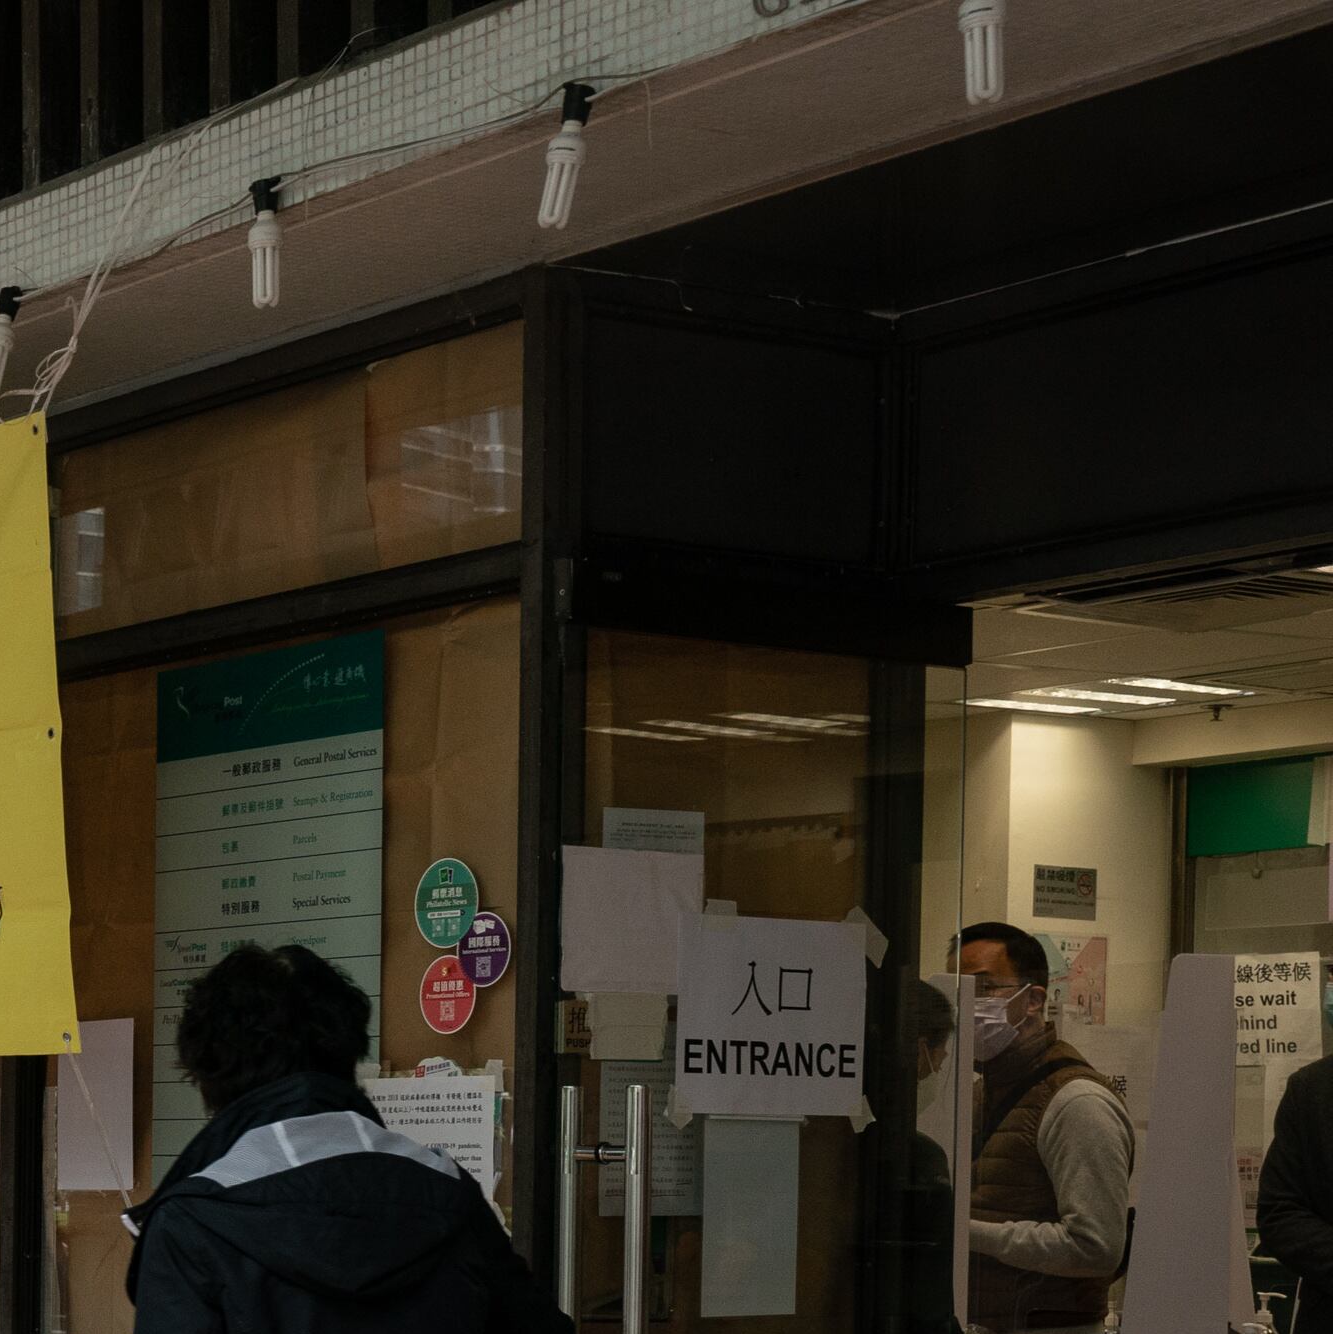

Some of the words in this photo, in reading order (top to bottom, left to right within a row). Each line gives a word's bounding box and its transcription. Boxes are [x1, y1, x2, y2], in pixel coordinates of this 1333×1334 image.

[294, 752, 322, 768] General
[323, 750, 346, 763] Postal
[347, 747, 378, 760] Services
[222, 758, 282, 777] 一般郵政服務
[293, 797, 319, 808] Stamps
[320, 794, 327, 803] &
[330, 789, 374, 803] Registration
[293, 832, 318, 845] Parcels
[292, 870, 314, 882] Postal
[315, 869, 347, 881] Payment
[221, 900, 261, 916] 特別服務
[292, 896, 319, 910] Special
[320, 894, 351, 906] Services
[1233, 962, 1312, 985] 線後等候
[731, 960, 814, 1016] 入口
[1260, 990, 1297, 1006] wait
[1236, 1014, 1277, 1031] hind
[566, 1037, 590, 1049] PUSH
[1266, 1039, 1297, 1053] line
[684, 1038, 857, 1078] ENTRANCE
[458, 1142, 483, 1150] pandemic,
